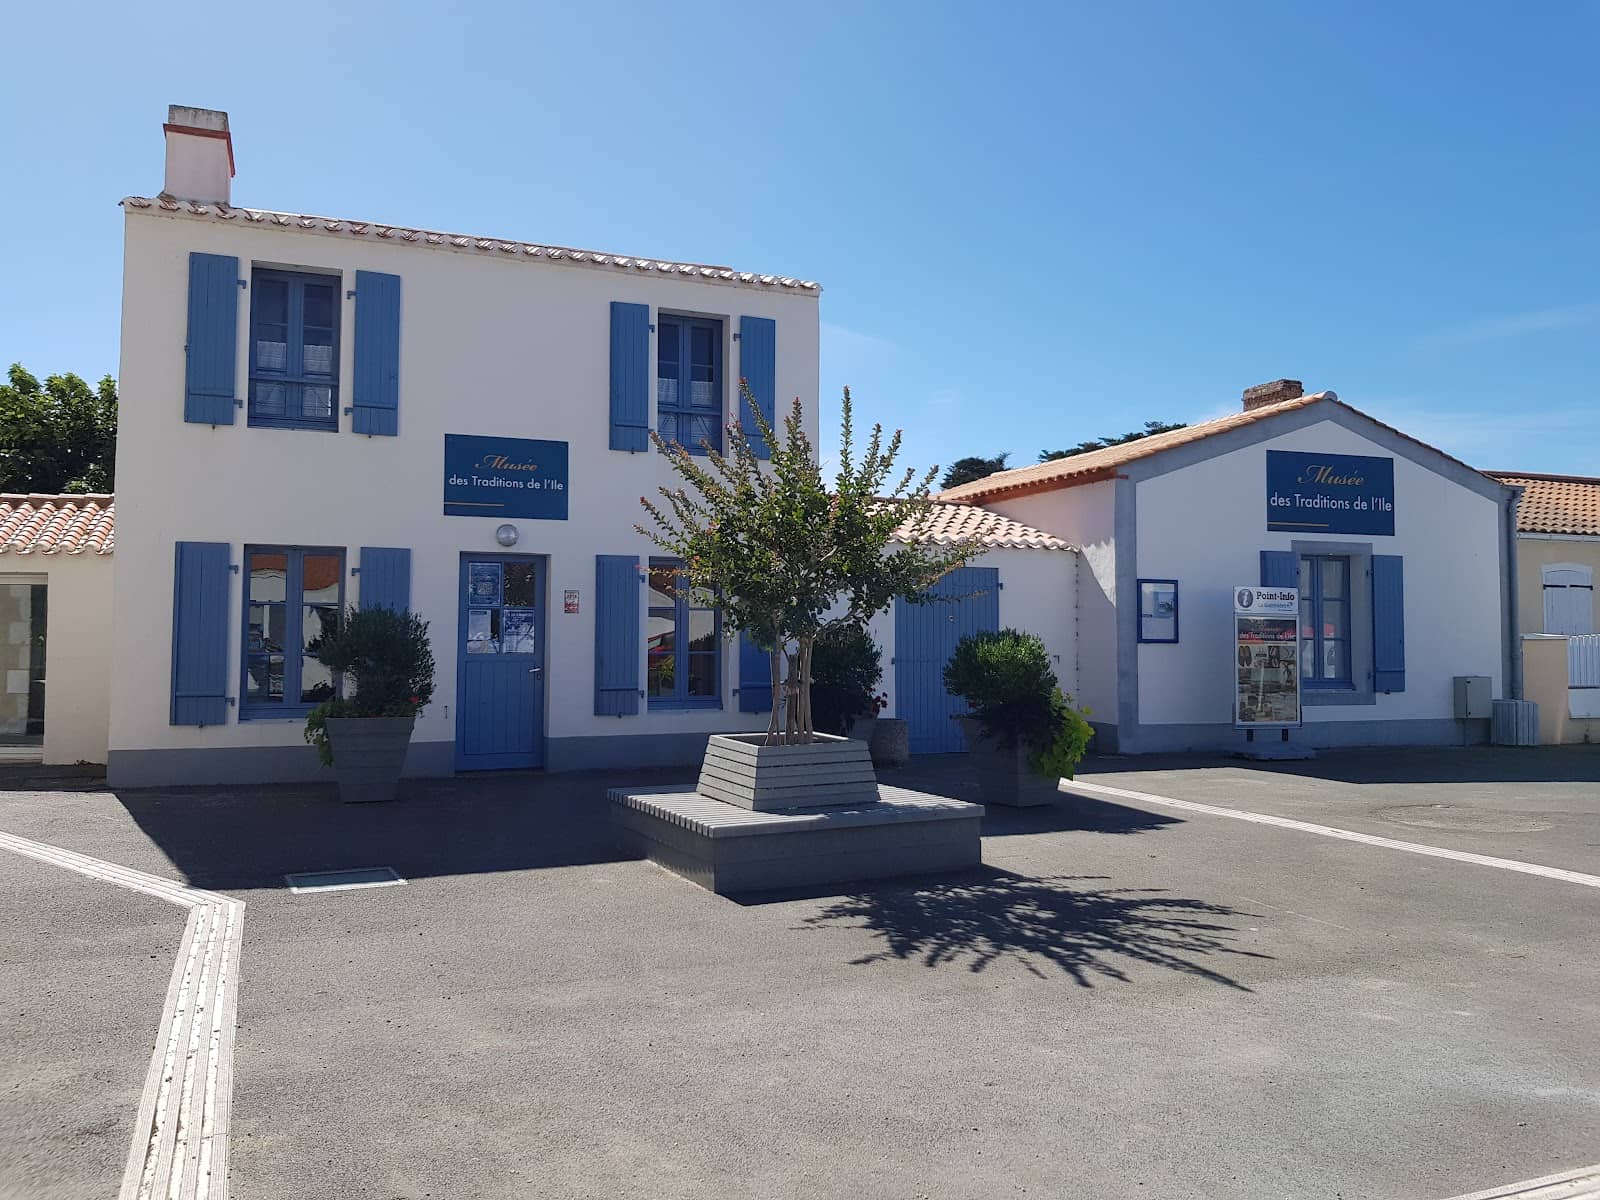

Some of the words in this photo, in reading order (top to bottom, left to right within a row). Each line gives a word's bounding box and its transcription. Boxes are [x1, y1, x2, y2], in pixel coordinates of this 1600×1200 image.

[475, 454, 538, 472] Musée
[449, 474, 468, 486] des
[472, 475, 524, 489] Traditions
[527, 478, 541, 489] de
[544, 479, 564, 490] l'Ile
[1297, 464, 1364, 486] Musée
[1270, 491, 1291, 507] des
[1294, 493, 1350, 510] Traditions
[1353, 496, 1368, 510] de
[1371, 497, 1392, 512] l'Ile
[1256, 591, 1295, 600] Point-Info
